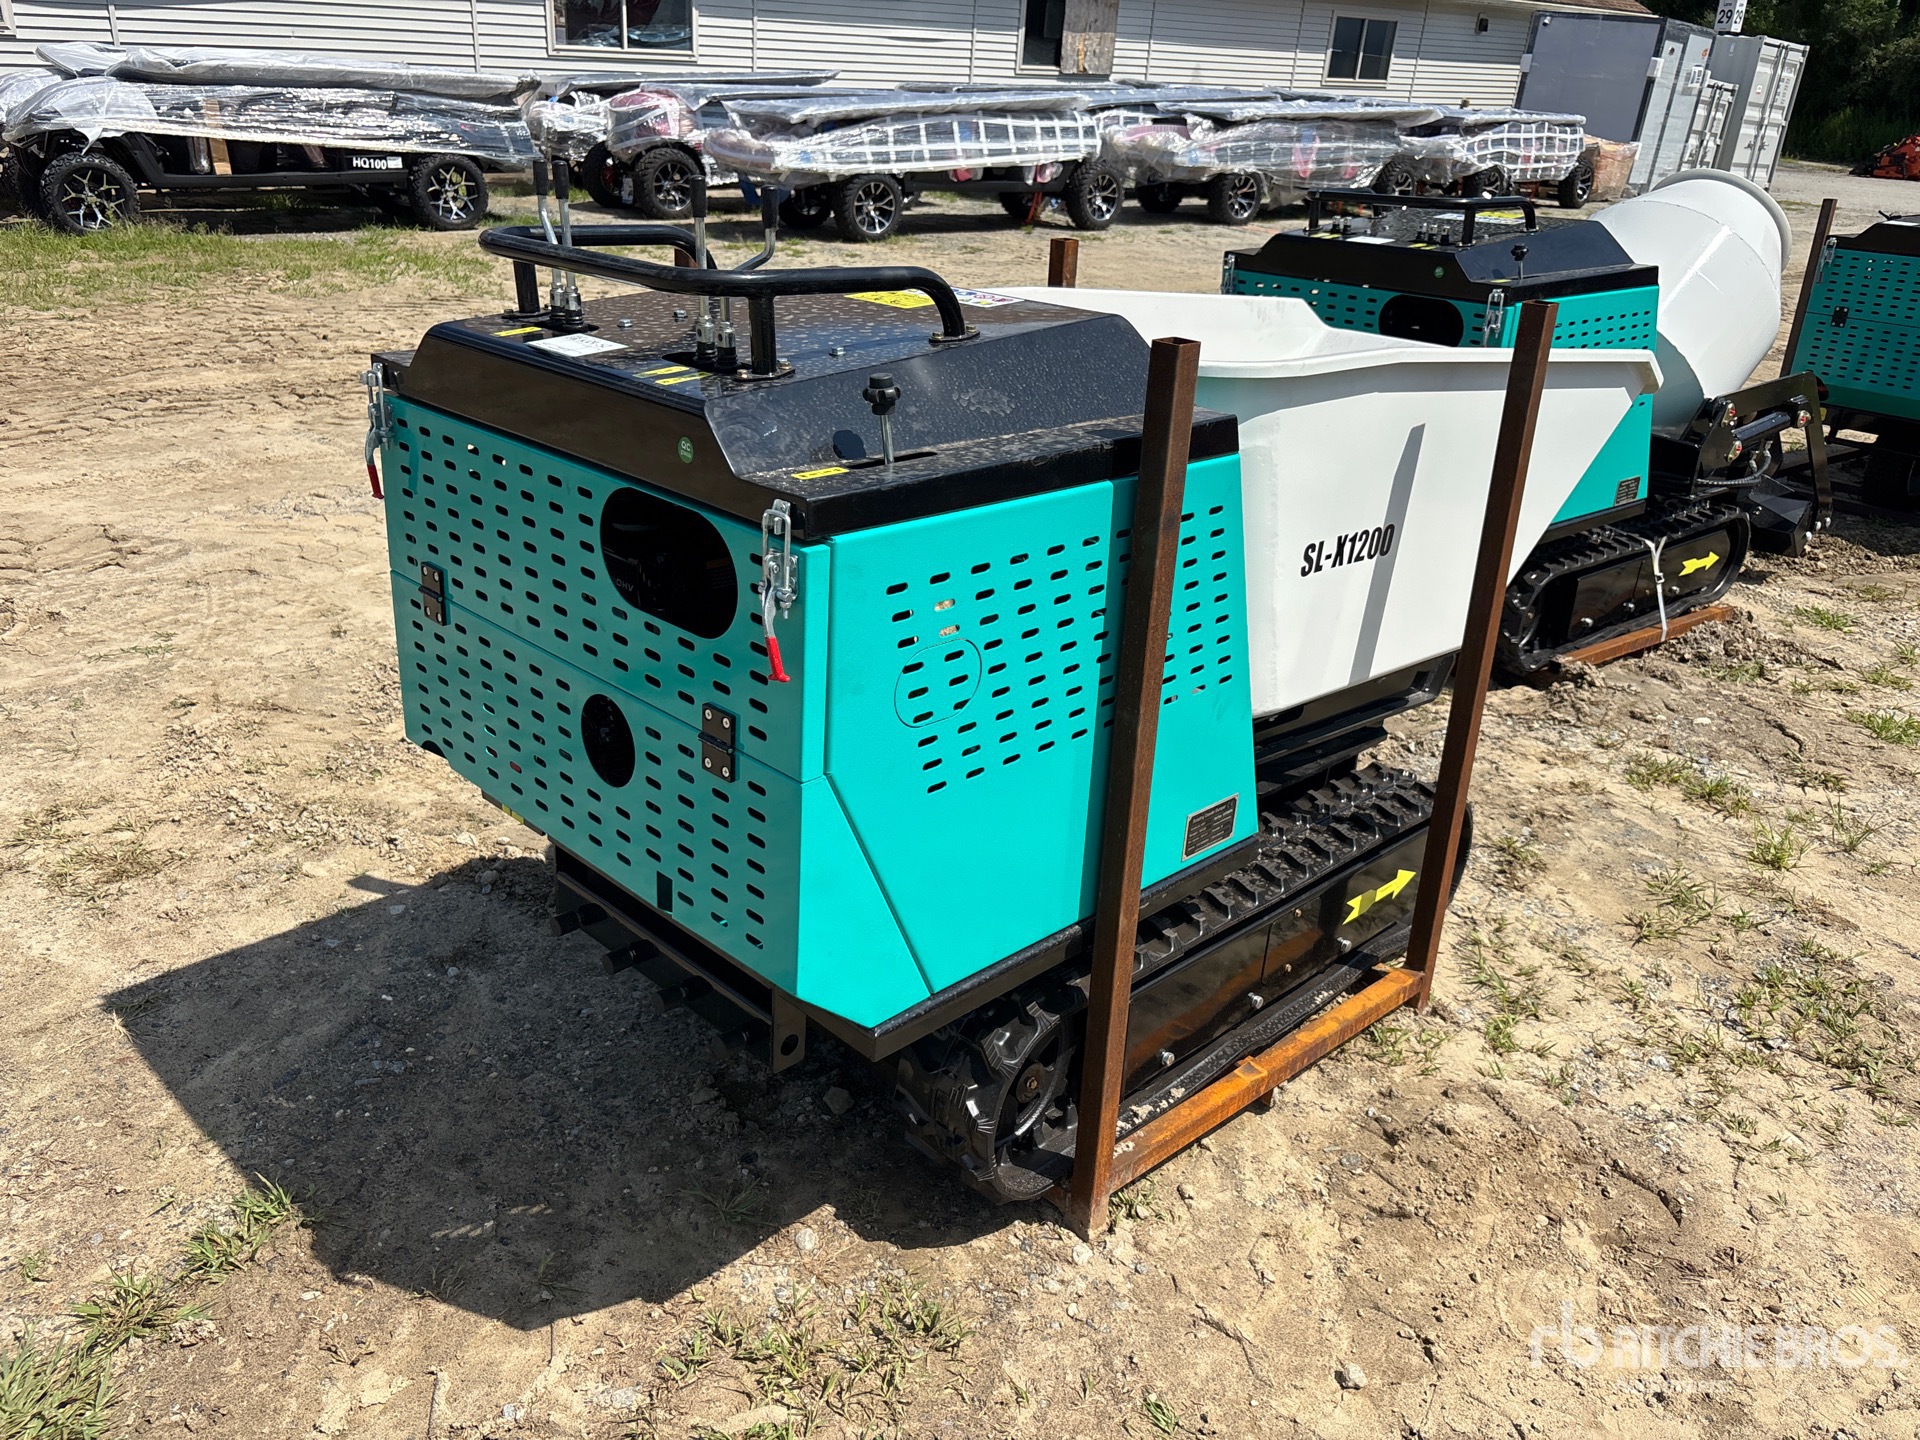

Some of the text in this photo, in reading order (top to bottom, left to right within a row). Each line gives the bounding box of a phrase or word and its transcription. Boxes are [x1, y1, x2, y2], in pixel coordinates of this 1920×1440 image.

[1717, 9, 1733, 24] 29
[1734, 9, 1744, 24] 29
[352, 156, 387, 170] HQ100
[681, 441, 691, 451] QC
[1300, 523, 1395, 577] SL-X1200
